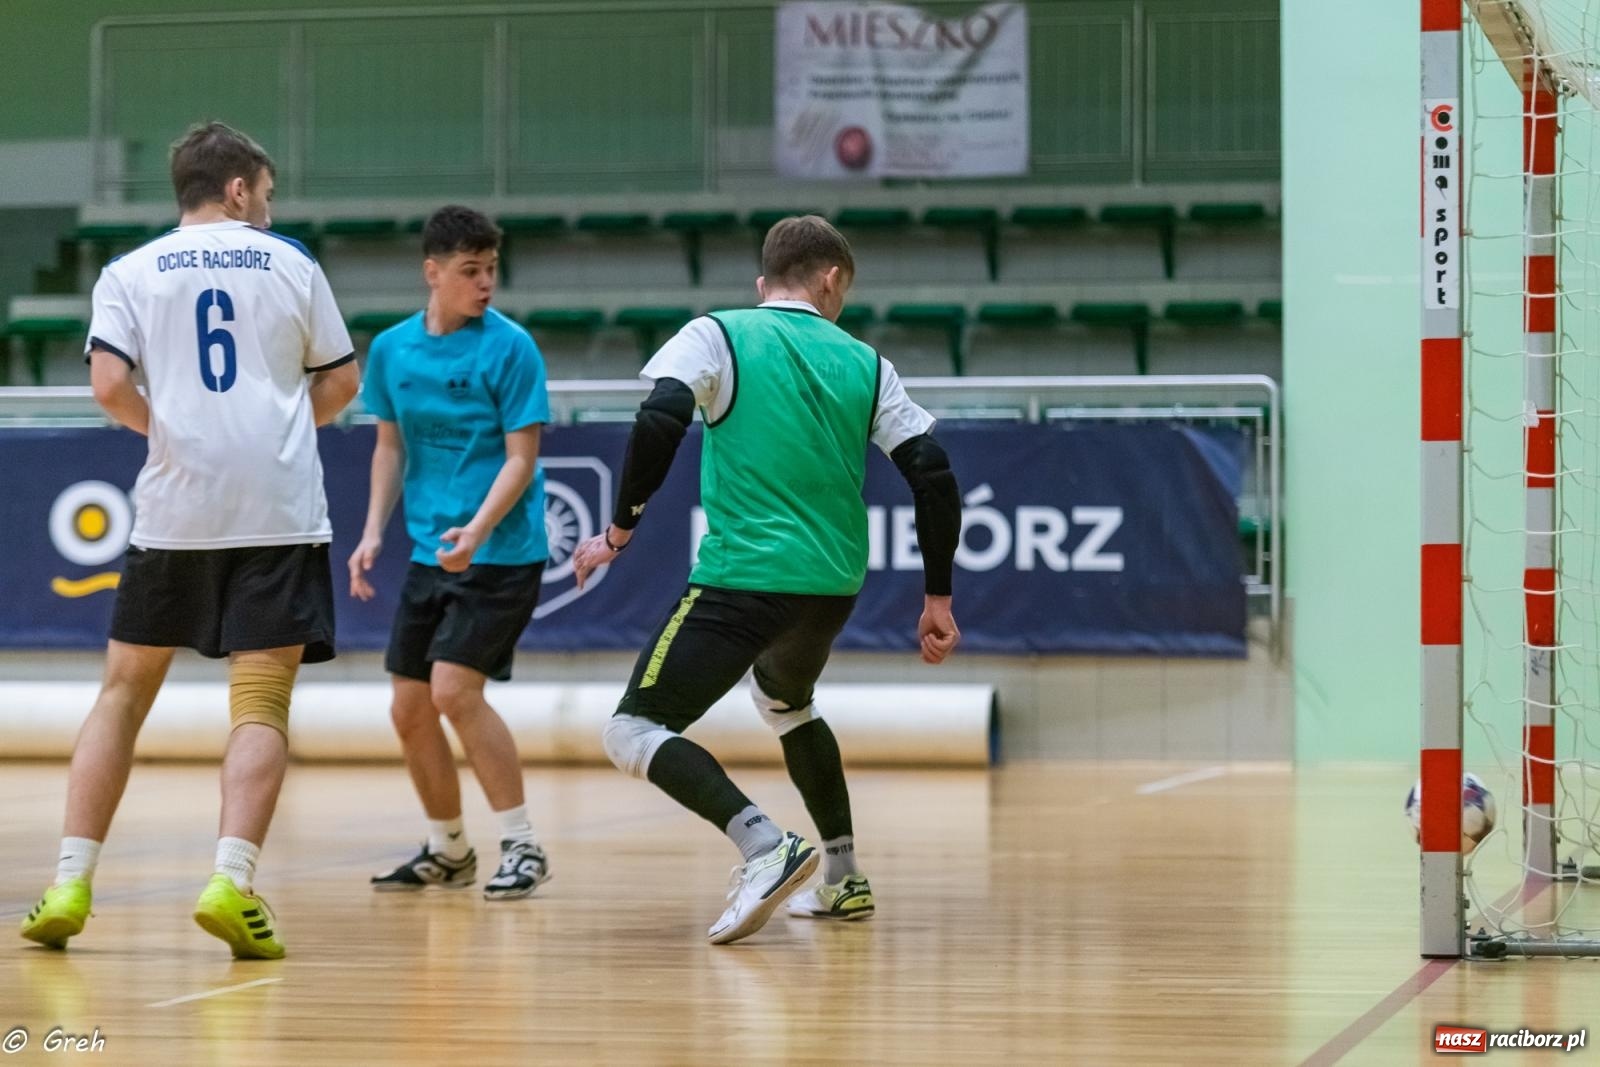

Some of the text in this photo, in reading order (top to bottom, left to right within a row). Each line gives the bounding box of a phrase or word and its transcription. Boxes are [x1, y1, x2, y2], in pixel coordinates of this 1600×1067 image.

[157, 246, 271, 272] OCICE RACIBÓRZ
[1434, 208, 1449, 305] sport
[196, 287, 237, 393] 6
